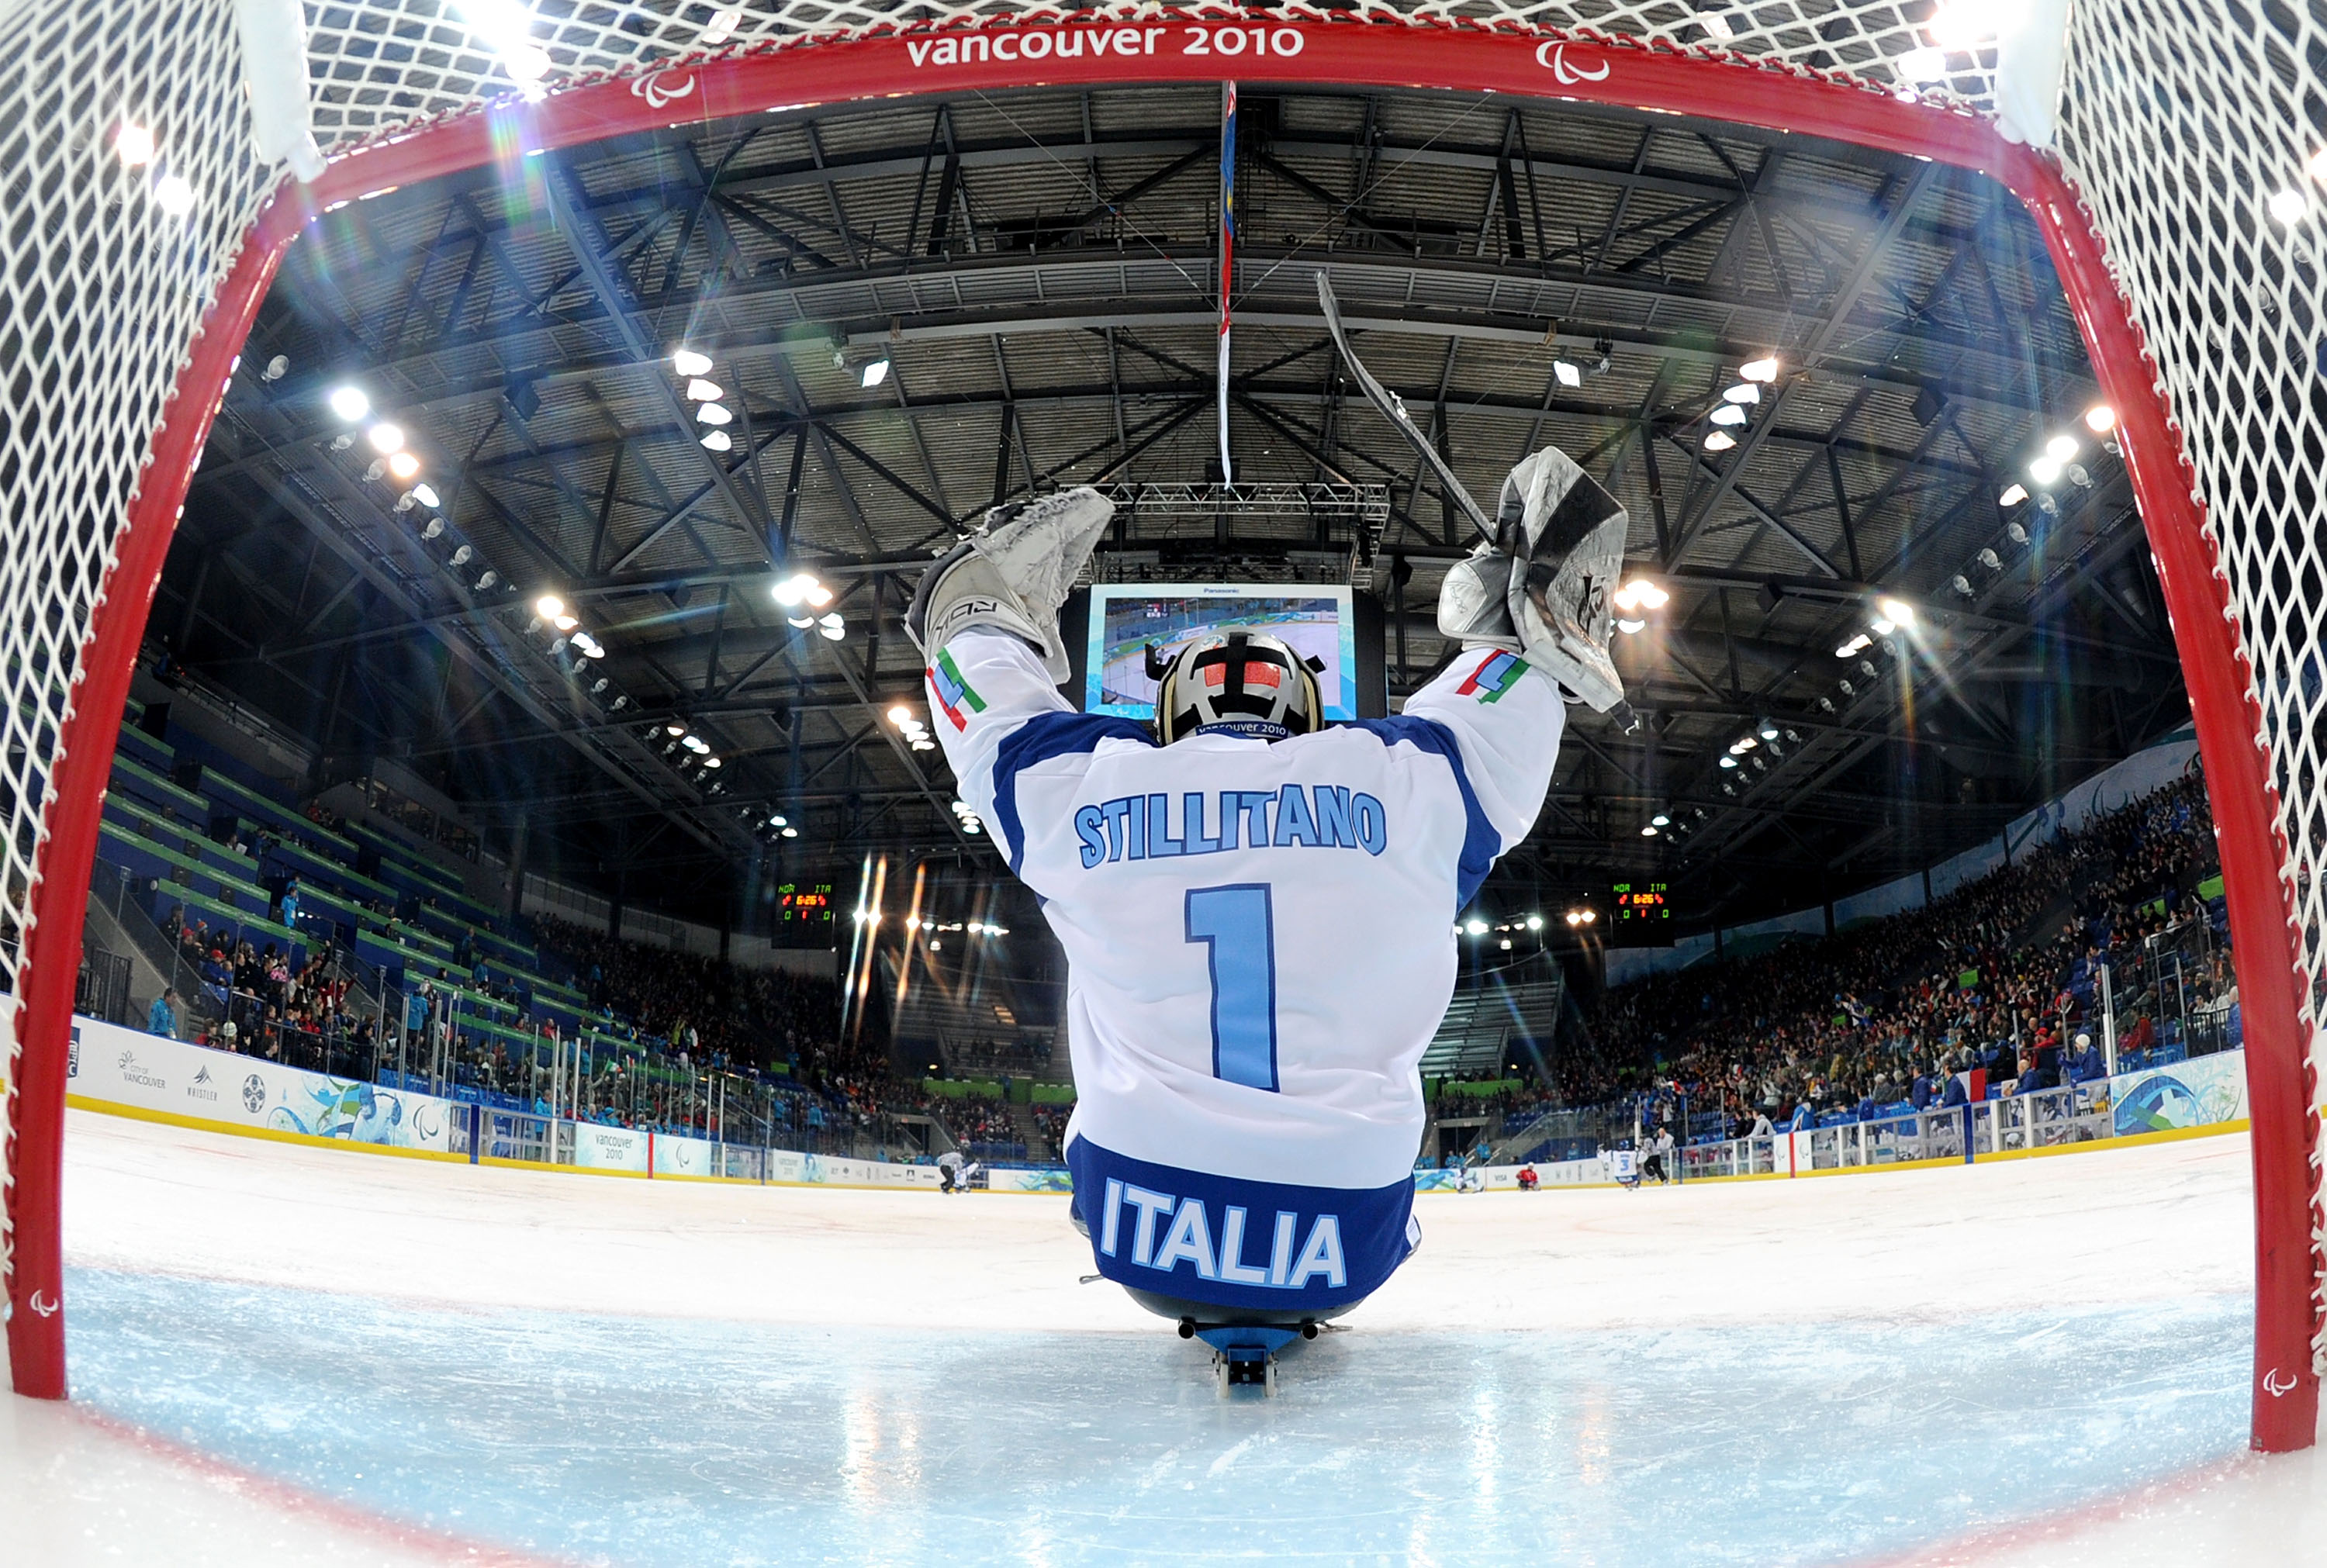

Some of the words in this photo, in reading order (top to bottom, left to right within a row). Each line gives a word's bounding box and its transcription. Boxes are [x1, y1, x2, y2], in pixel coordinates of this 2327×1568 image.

[907, 26, 1167, 67] vancouver
[1183, 26, 1304, 57] 2010
[1261, 724, 1286, 735] 2010
[1074, 783, 1387, 869] STILLITANO
[778, 884, 795, 893] NOR
[814, 884, 831, 893] ITA
[1613, 883, 1630, 893] NOR
[1651, 883, 1667, 893] ITA
[784, 910, 791, 920] 0
[823, 910, 830, 920] 0
[1623, 910, 1630, 919] 0
[1663, 909, 1669, 918] 0
[1184, 882, 1281, 1093] 1
[130, 1065, 141, 1073] CITY
[123, 1072, 166, 1089] VANCOUVER
[187, 1086, 218, 1102] WHISTLER
[596, 1135, 633, 1148] vancouver
[606, 1148, 623, 1160] 2010
[1101, 1176, 1347, 1290] ITALIA
